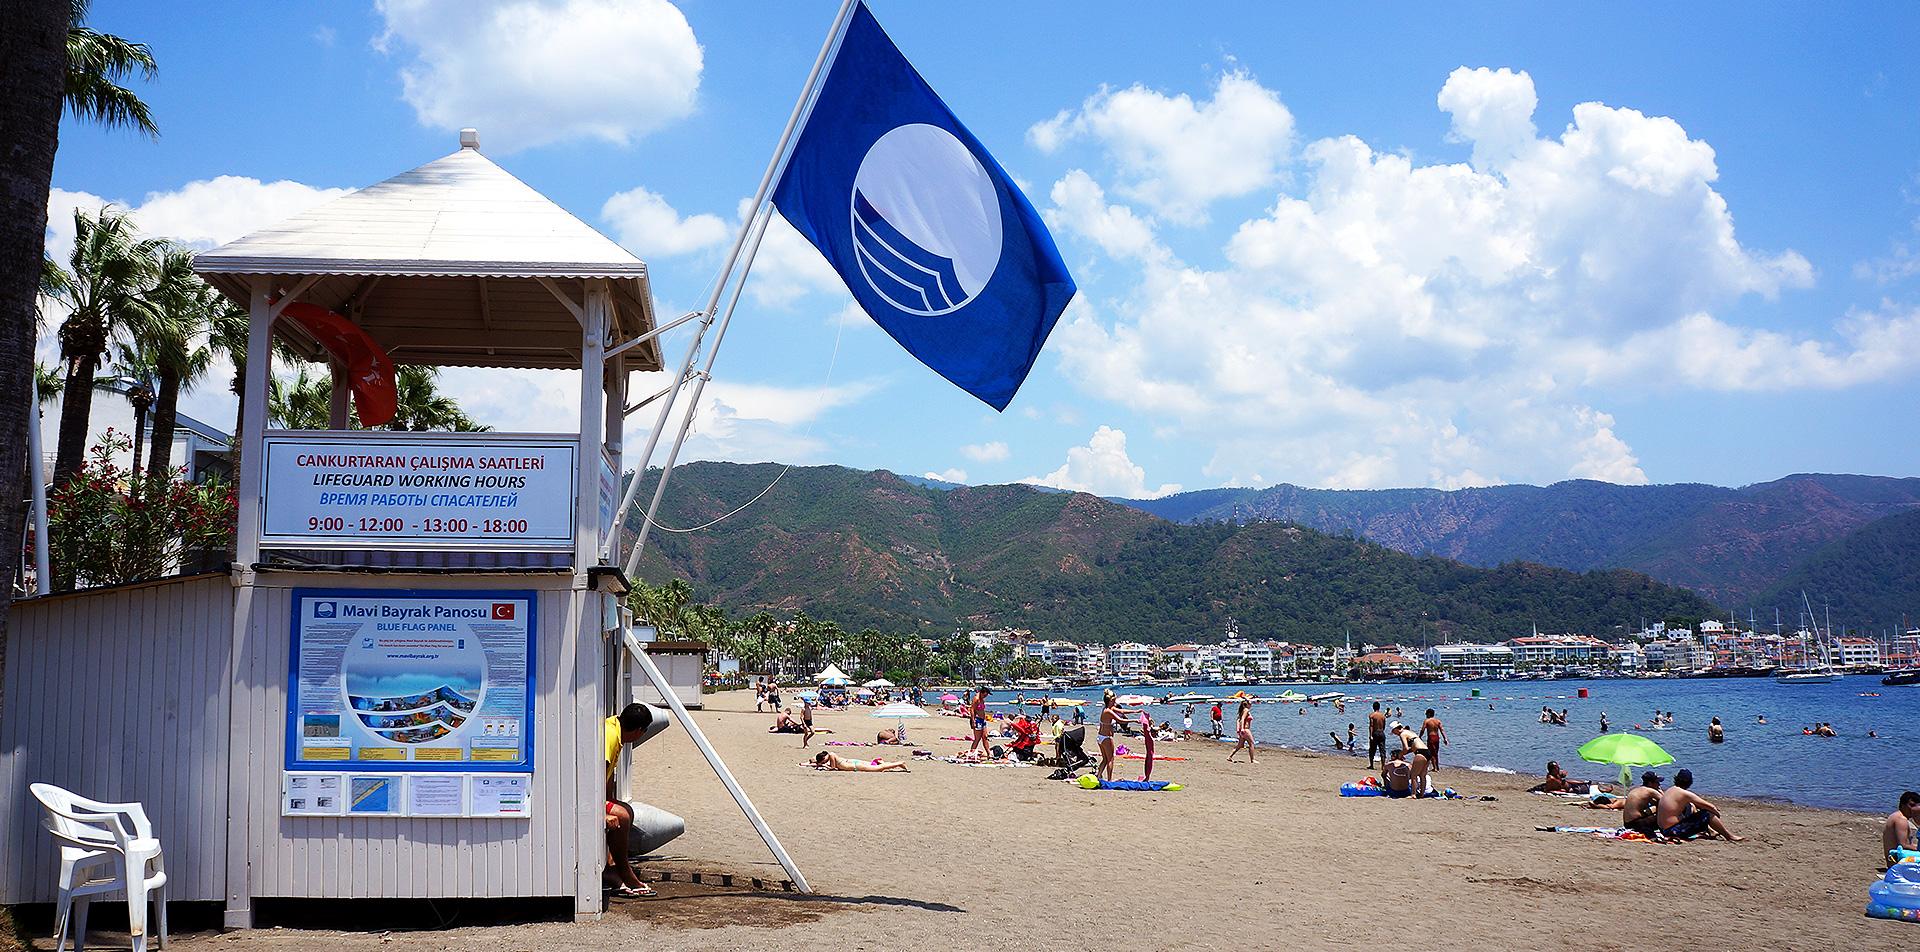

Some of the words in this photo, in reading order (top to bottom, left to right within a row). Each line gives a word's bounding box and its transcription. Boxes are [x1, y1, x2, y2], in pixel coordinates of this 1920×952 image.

[296, 454, 406, 468] CANKURTARAN
[410, 456, 475, 471] ÇALIŞMA
[478, 455, 545, 470] SAATLERİ
[313, 474, 394, 487] LIFEGUARD
[398, 475, 471, 488] WORKING
[474, 476, 526, 489] HOURS
[320, 492, 368, 506] ВРЕМЯ
[370, 493, 428, 506] РАБОТЫ
[431, 492, 518, 507] СПАСАТЕЛЕЙ
[308, 517, 344, 531] 9:00
[359, 517, 404, 532] 12:00
[423, 518, 468, 533] 13:00
[483, 519, 528, 533] 18:00
[343, 605, 378, 618] Mavi
[381, 605, 430, 621] Bayrak
[434, 606, 487, 618] Panosu
[376, 622, 400, 631] BLUE
[402, 623, 425, 632] FLAG
[427, 623, 457, 632] PANEL
